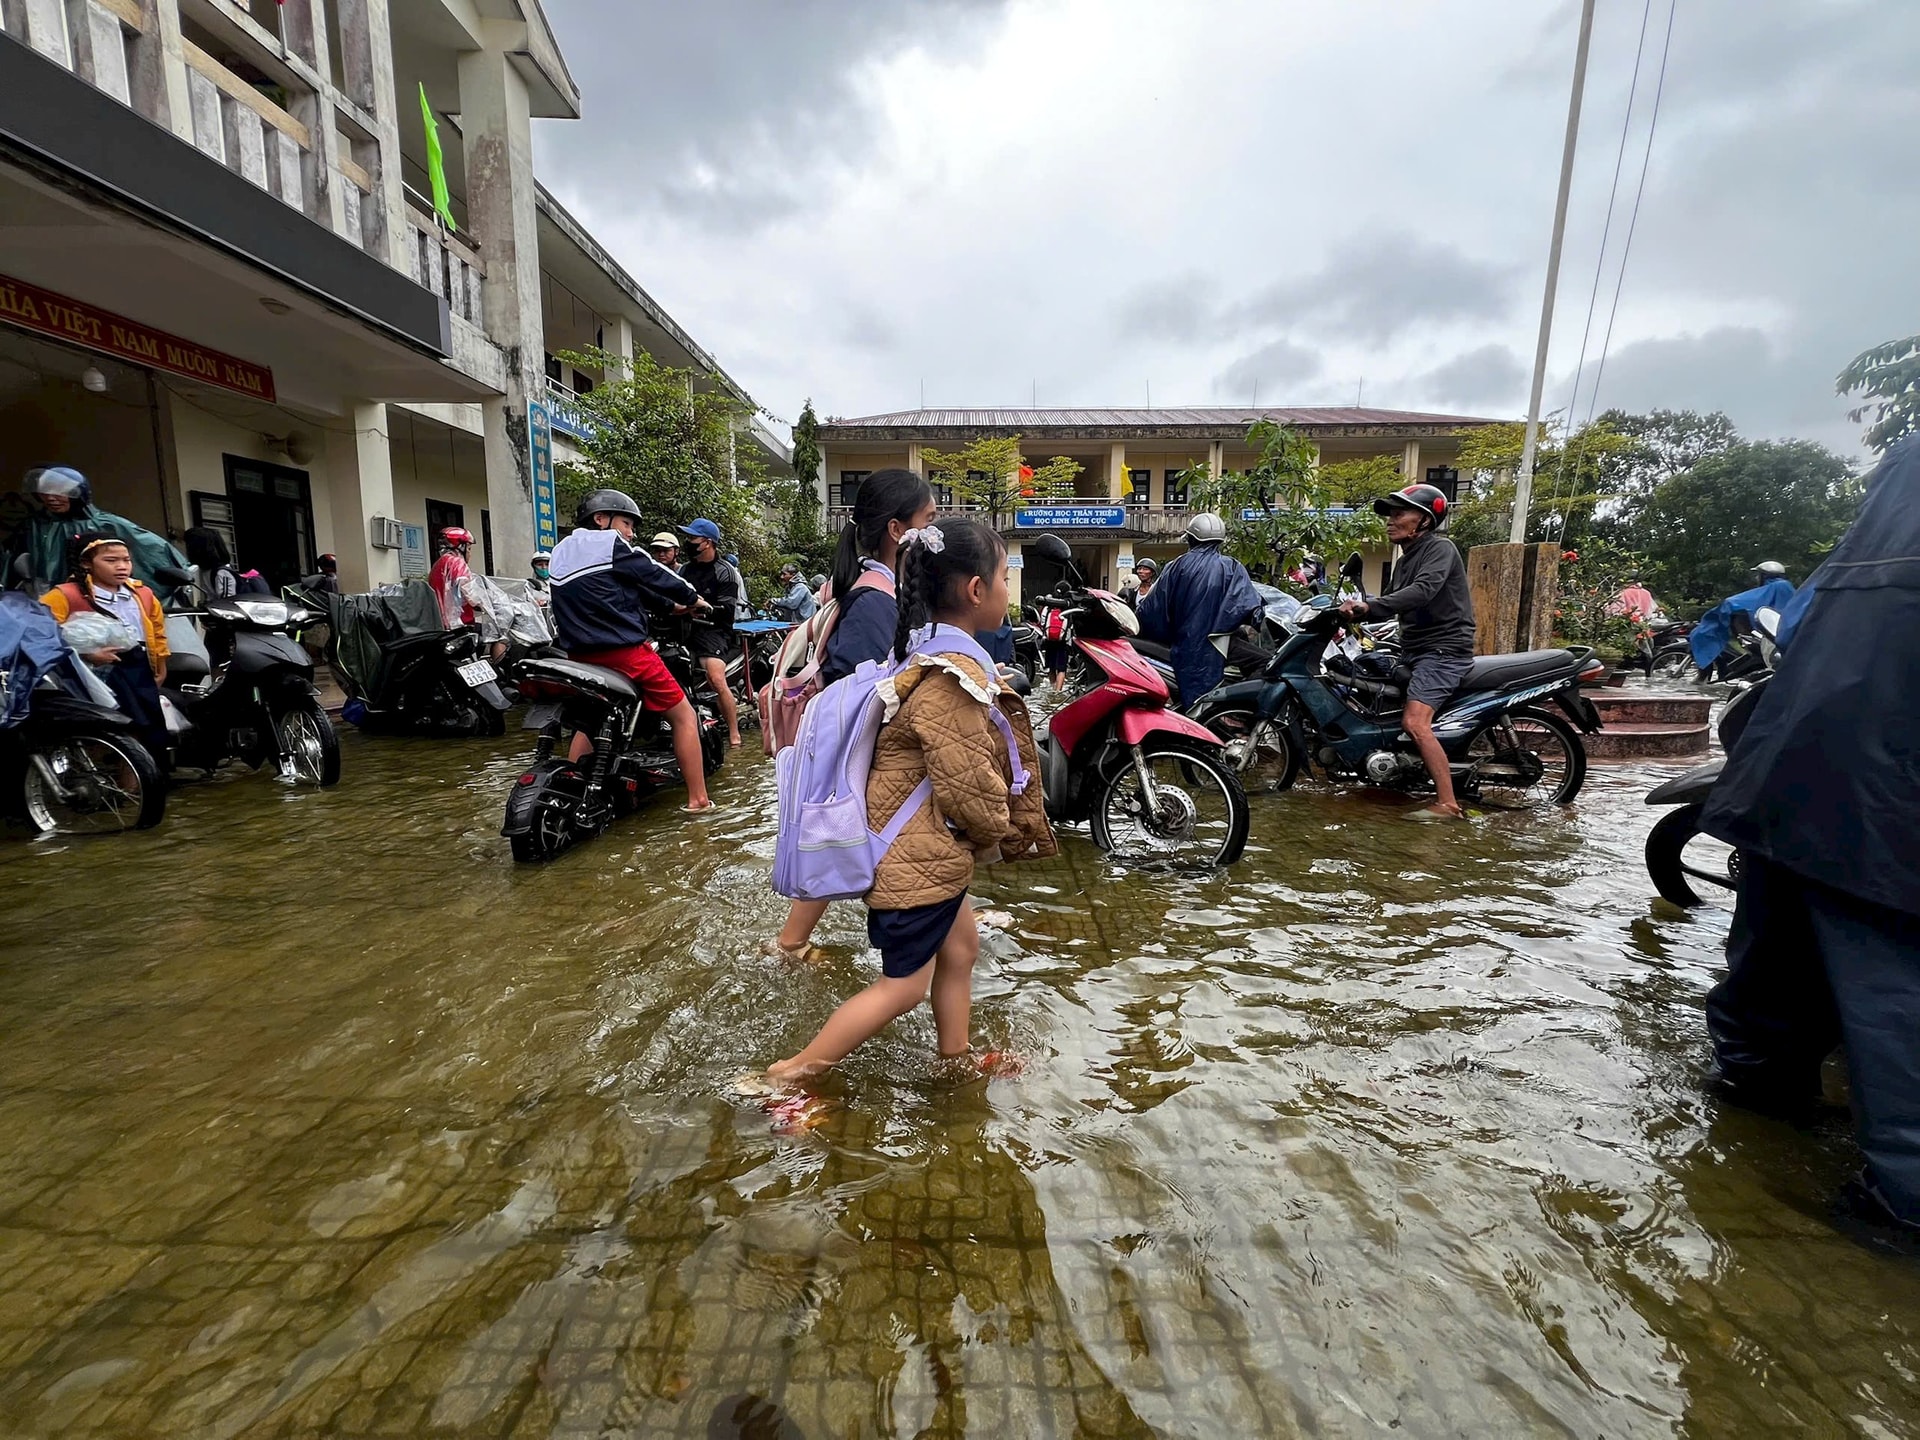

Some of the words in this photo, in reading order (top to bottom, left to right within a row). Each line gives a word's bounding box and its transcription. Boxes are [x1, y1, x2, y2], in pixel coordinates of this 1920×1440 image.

[43, 301, 102, 341] VIỆT
[111, 324, 161, 360] NAM
[165, 343, 219, 378] MUÔN
[223, 363, 263, 393] NĂM
[1024, 509, 1053, 517] TRƯỜNG
[1055, 510, 1071, 518] HỌC
[1073, 509, 1093, 517] THÂN
[1095, 509, 1118, 518] THIỆN
[1072, 516, 1090, 525] TÍCH
[1092, 517, 1107, 525] CỰC
[1104, 685, 1128, 696] HONDA
